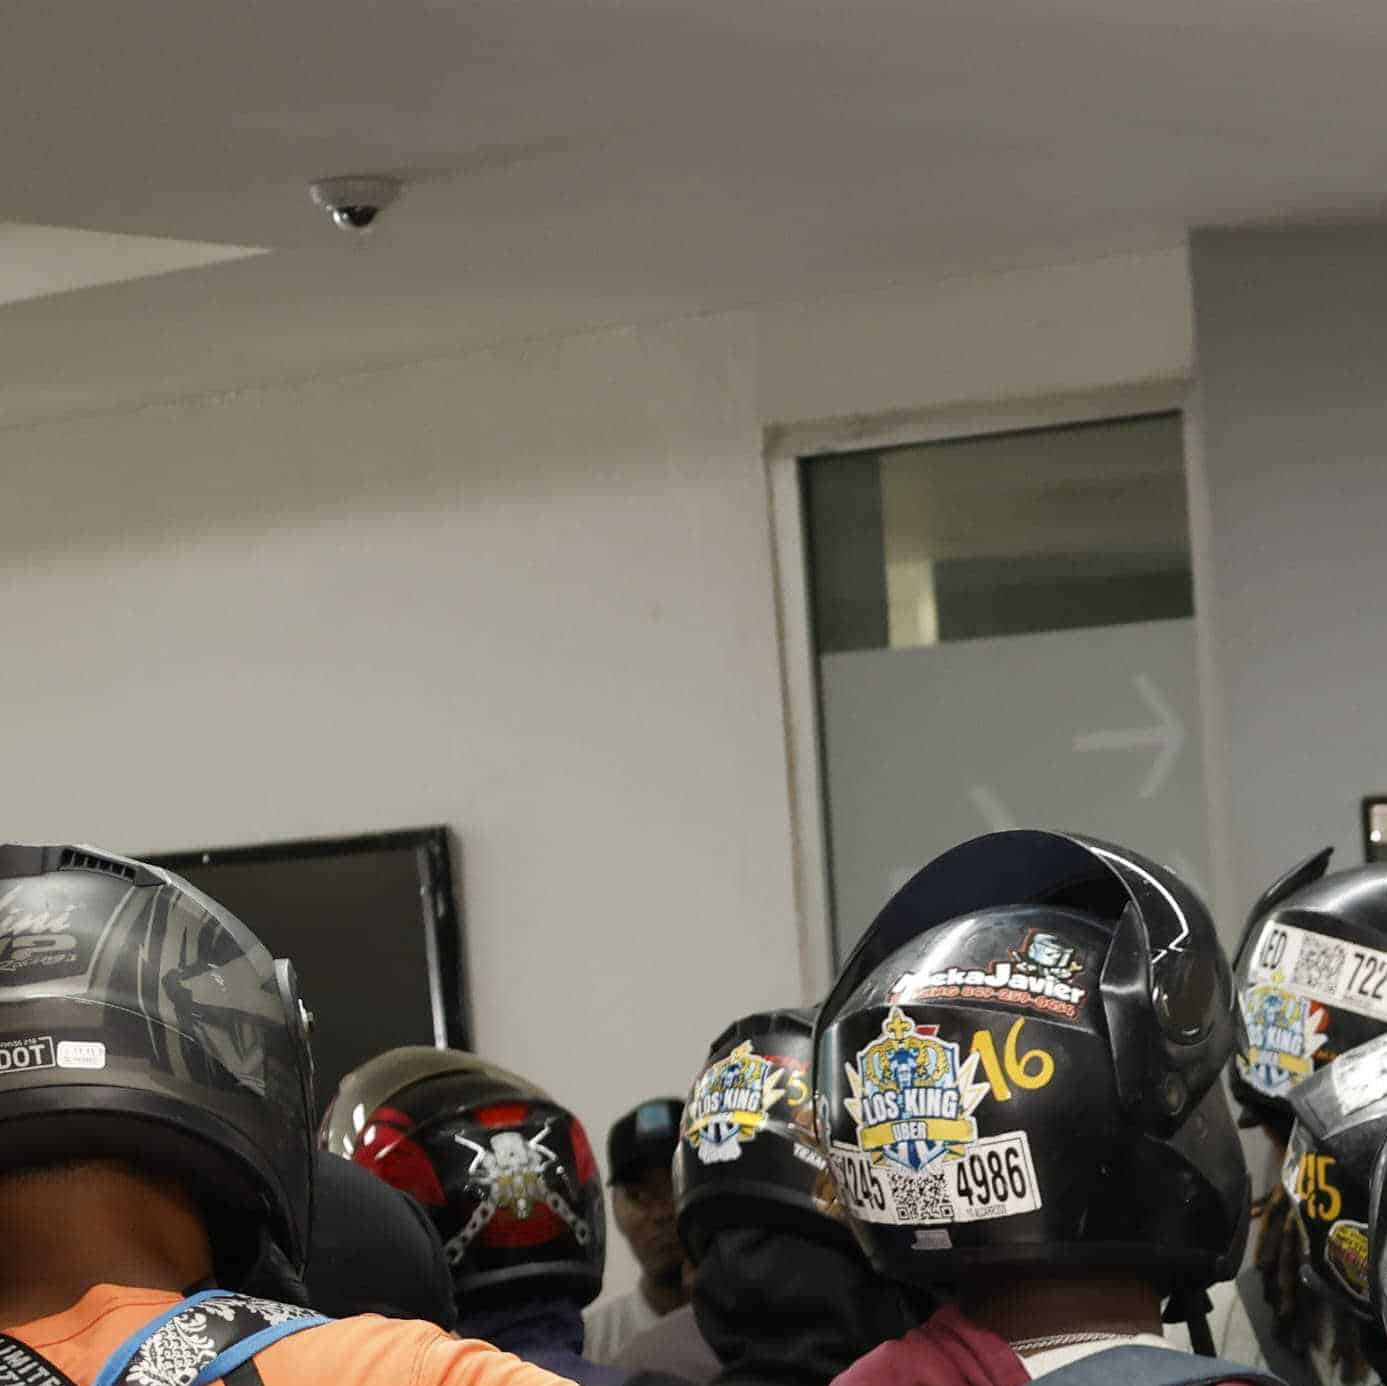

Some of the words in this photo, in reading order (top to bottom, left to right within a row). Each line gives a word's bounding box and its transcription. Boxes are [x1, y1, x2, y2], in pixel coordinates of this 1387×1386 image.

[0, 1044, 46, 1070] DOT
[970, 1015, 1056, 1101] 16
[724, 1088, 761, 1111] KING
[863, 1091, 899, 1124] LOS
[904, 1087, 958, 1119] KING
[956, 1146, 1026, 1206] 4986
[1296, 1151, 1342, 1222] 45
